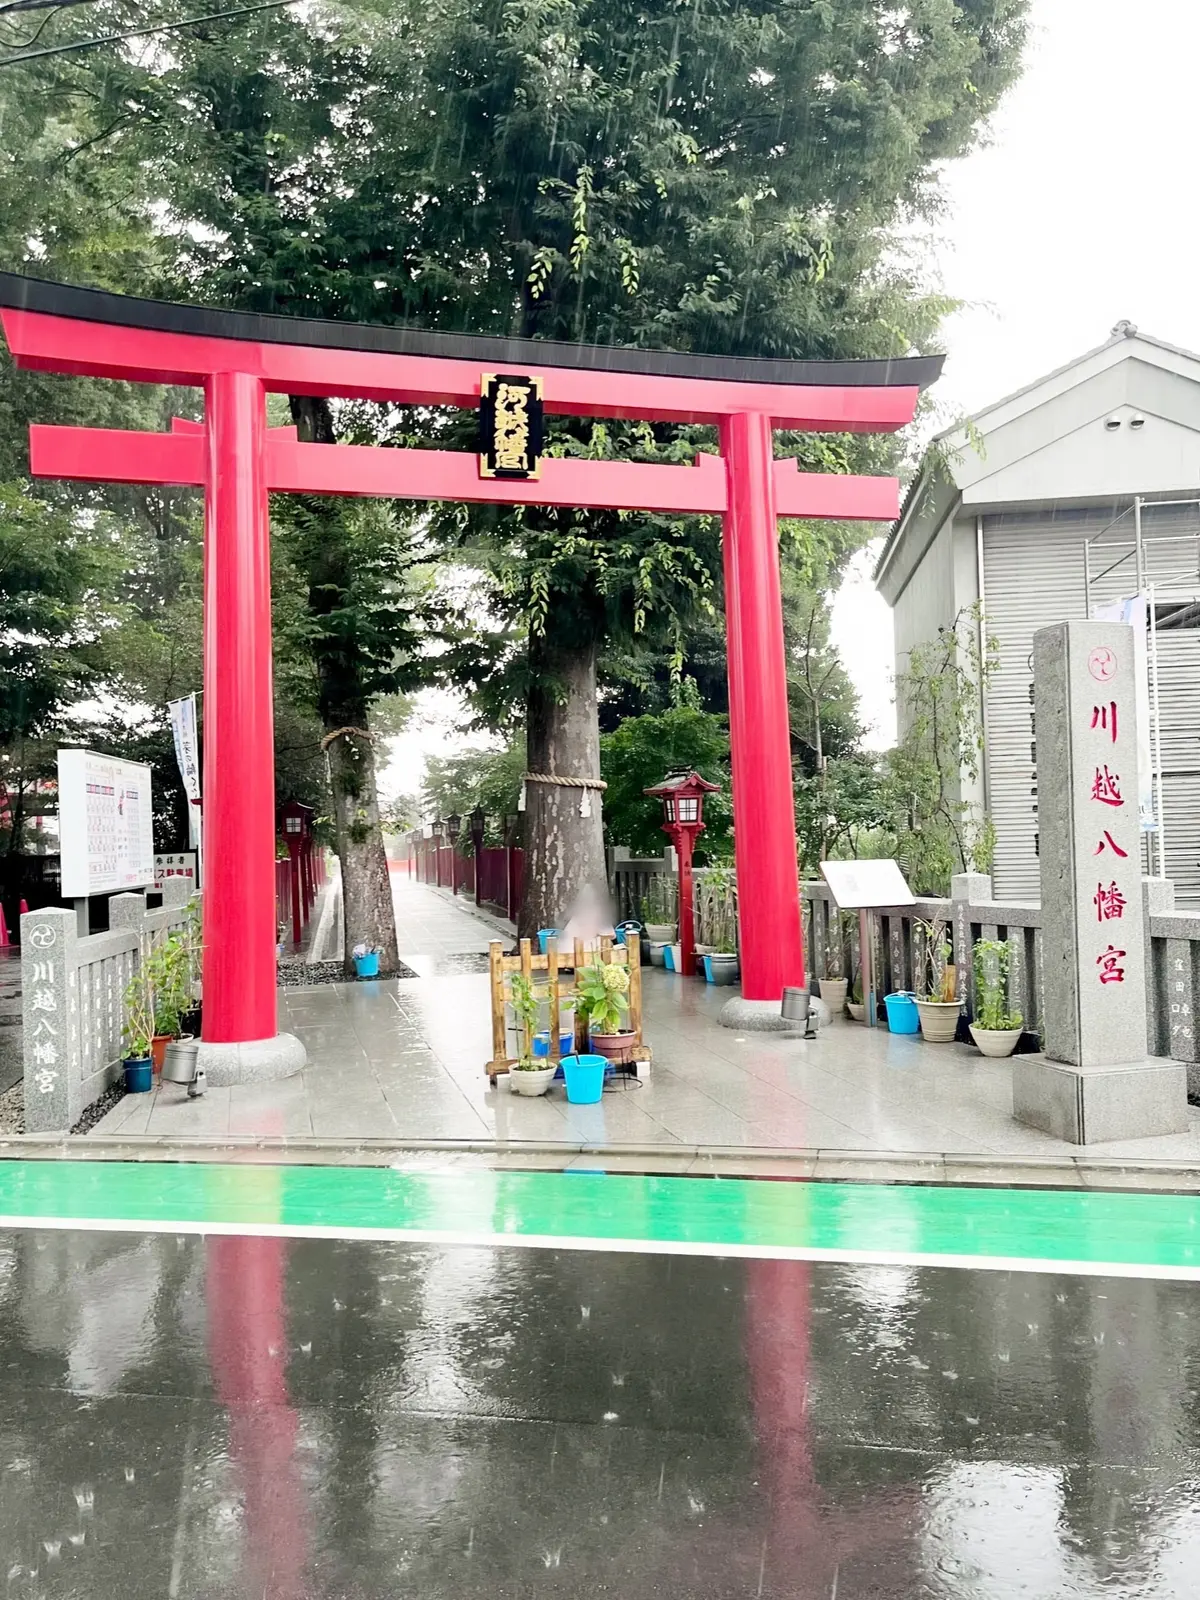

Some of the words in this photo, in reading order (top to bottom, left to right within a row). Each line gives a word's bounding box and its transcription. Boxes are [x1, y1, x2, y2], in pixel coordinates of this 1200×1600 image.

[1089, 700, 1128, 985] 川越八幡宮
[31, 960, 60, 1095] 川越八幡宮
